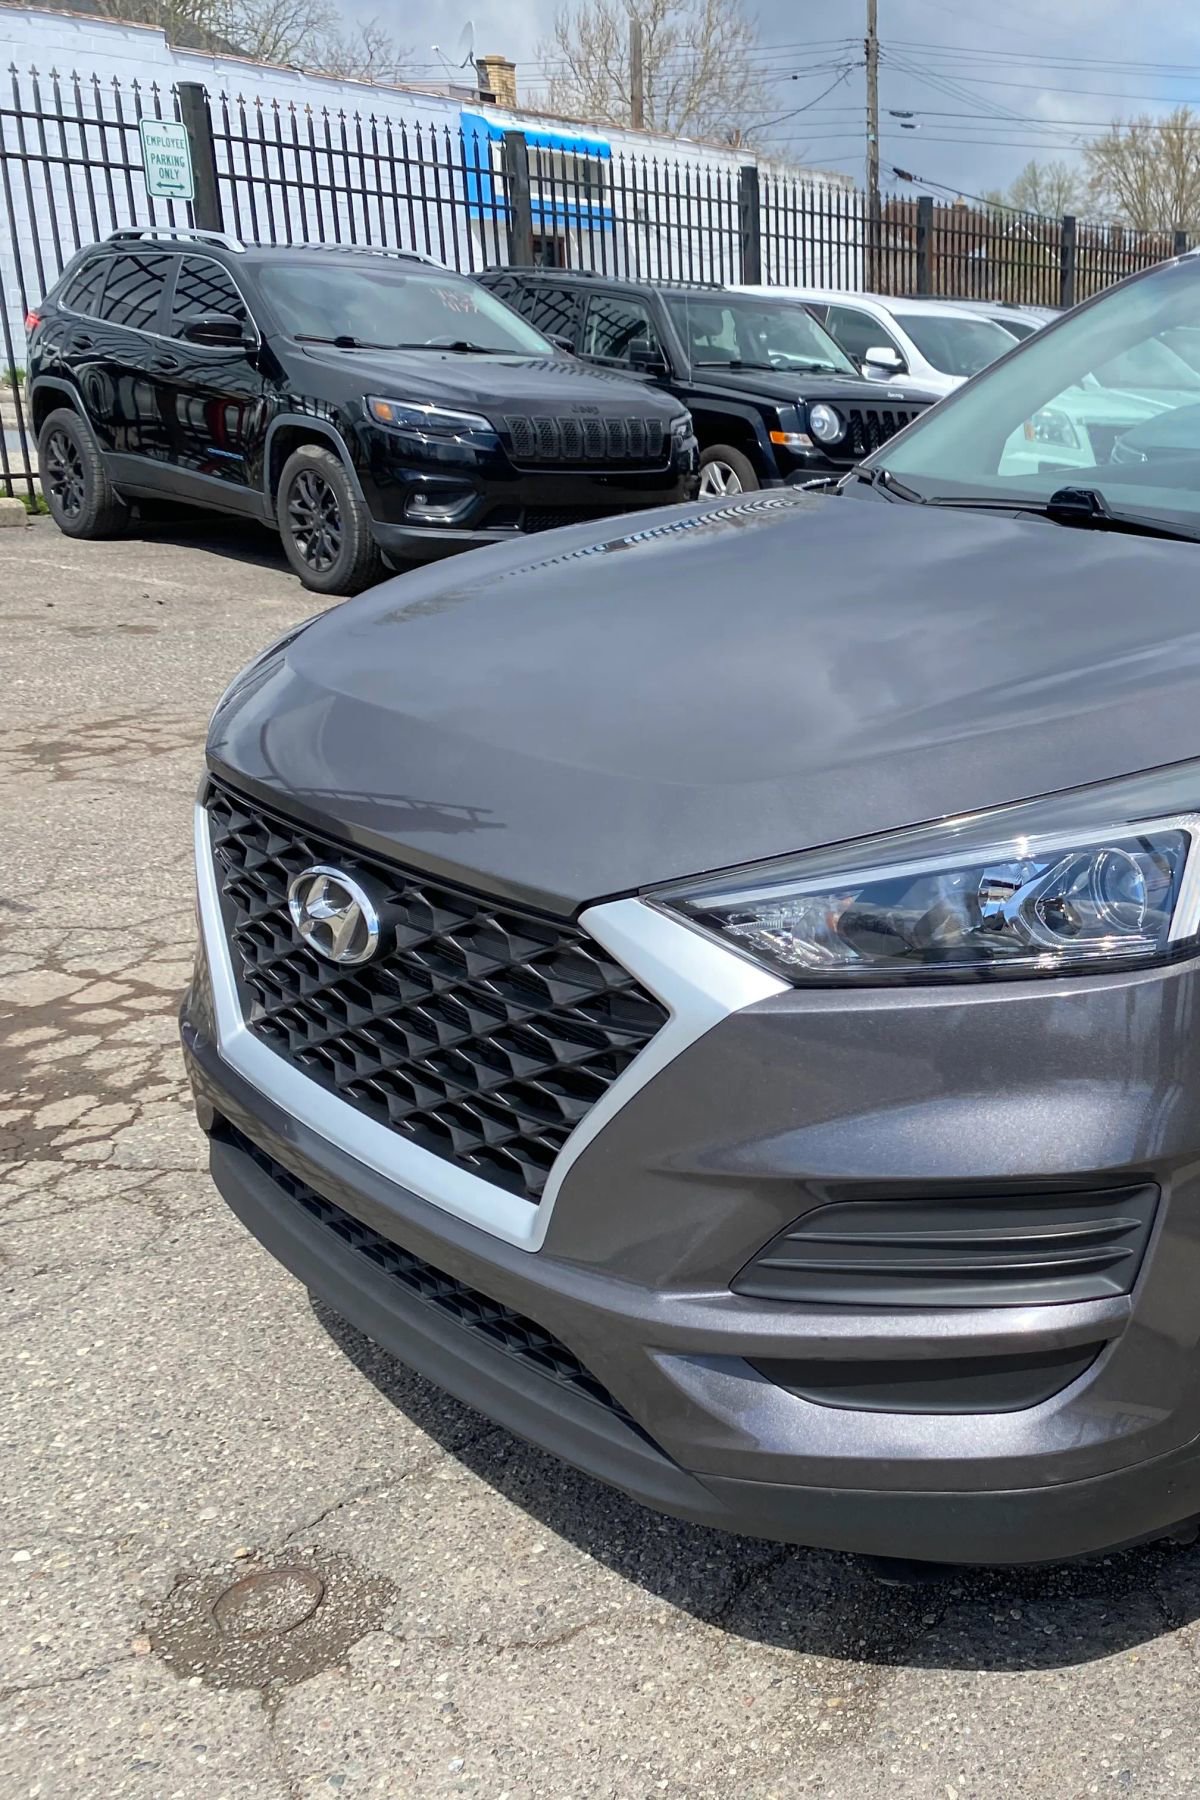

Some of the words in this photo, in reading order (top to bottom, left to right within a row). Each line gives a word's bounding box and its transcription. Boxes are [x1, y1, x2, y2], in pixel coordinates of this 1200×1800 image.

[145, 135, 185, 150] EMPLOYEE
[150, 153, 186, 168] PARKING
[158, 167, 180, 180] ONLY
